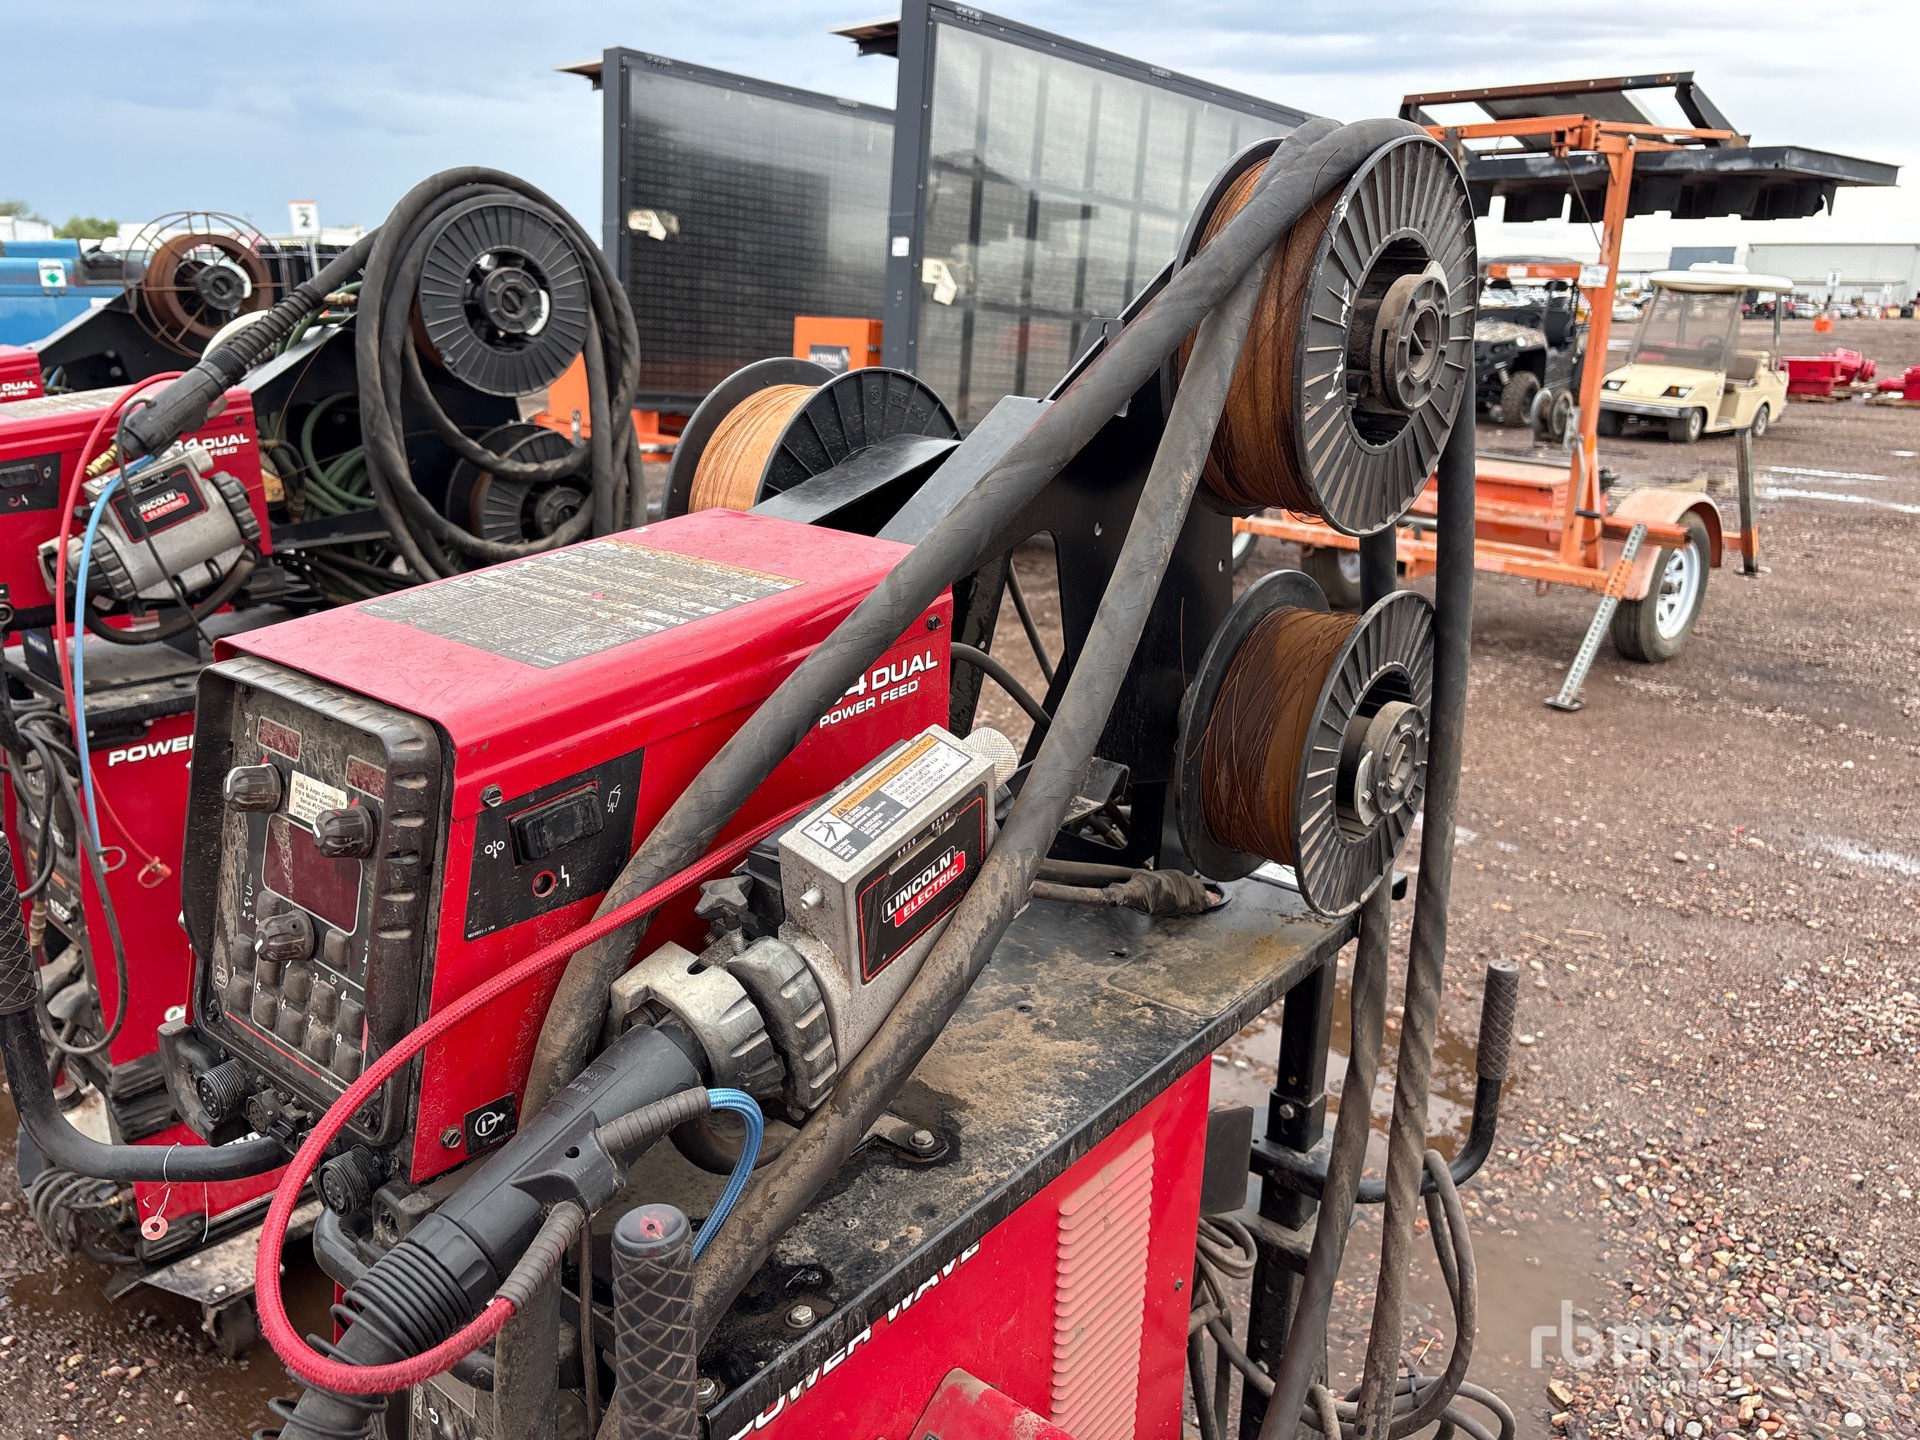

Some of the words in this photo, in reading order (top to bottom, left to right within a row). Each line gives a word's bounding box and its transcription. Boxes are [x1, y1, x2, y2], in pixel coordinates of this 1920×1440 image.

[299, 211, 312, 228] 2
[1, 381, 37, 392] DUAL
[201, 433, 250, 450] DUAL
[871, 650, 938, 691] DUAL
[819, 696, 876, 729] POWER
[881, 679, 918, 704] FEED
[842, 788, 869, 809] WARNING
[887, 851, 951, 917] LINCOLN
[903, 864, 958, 918] ELECTRIC
